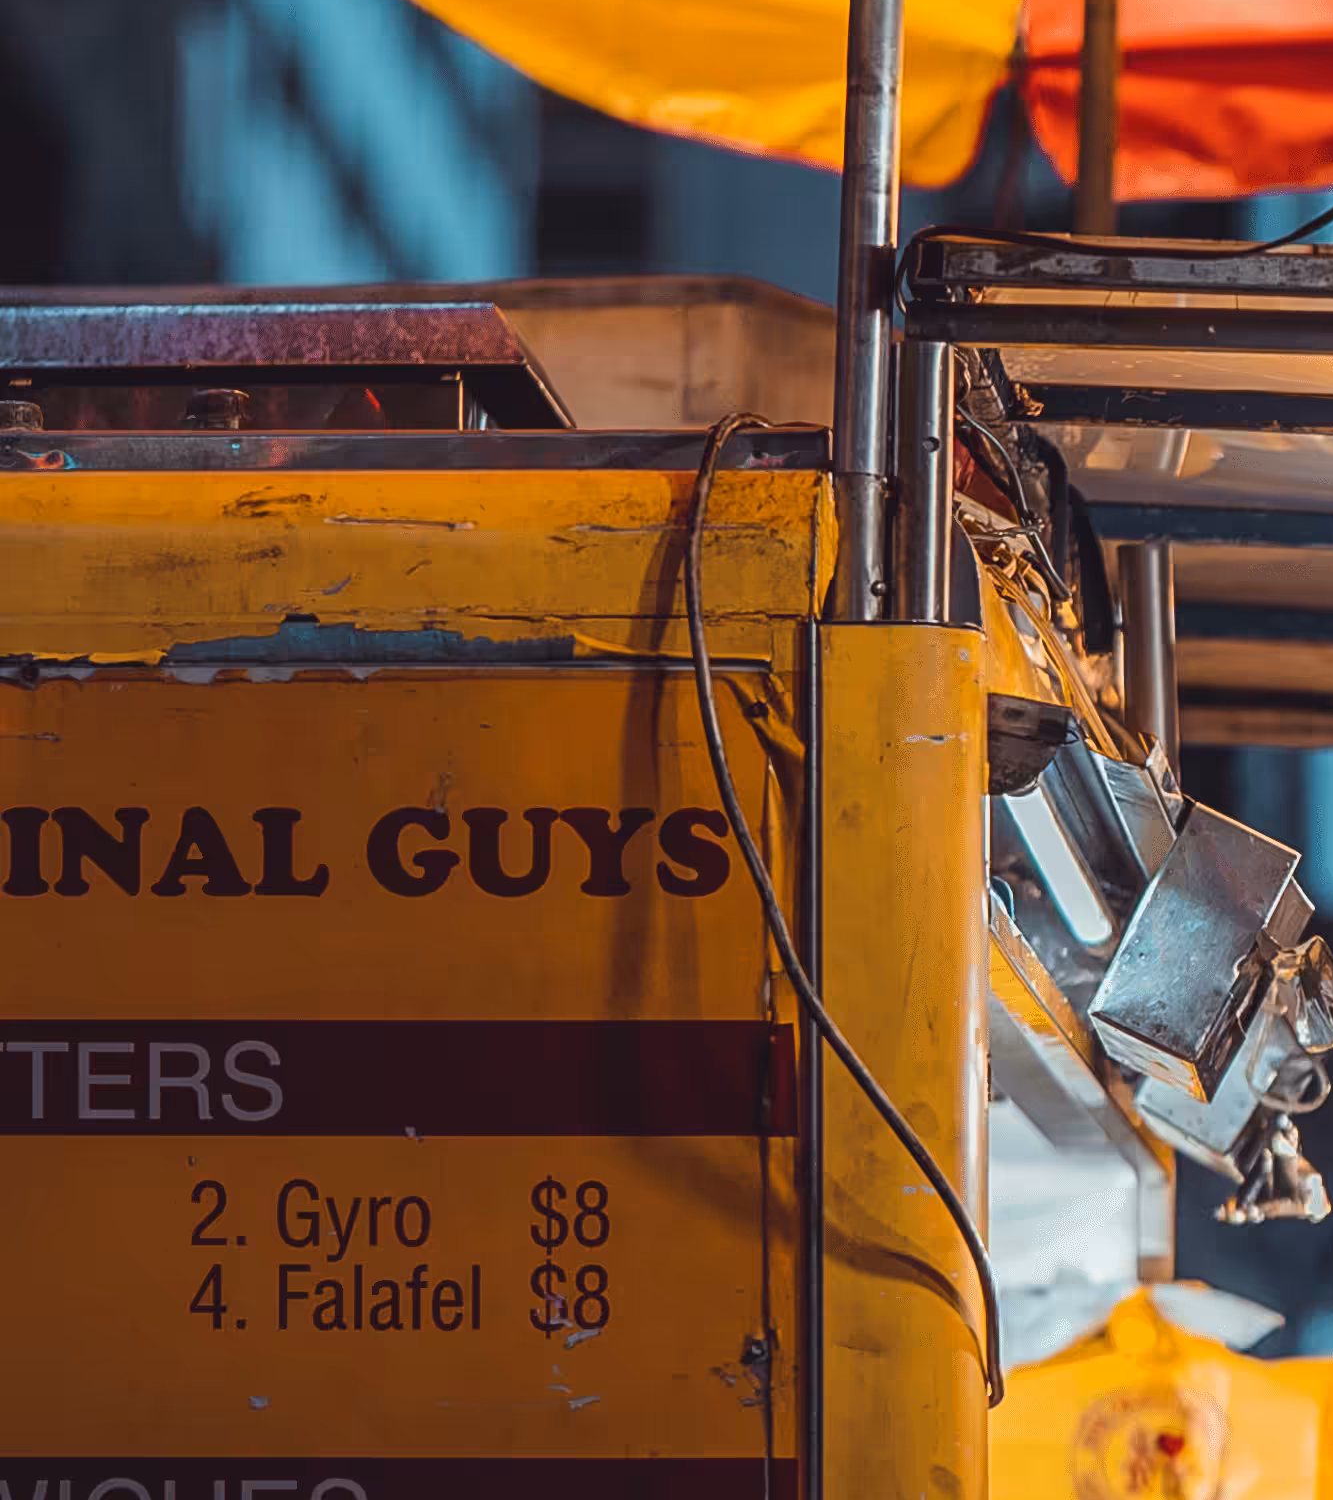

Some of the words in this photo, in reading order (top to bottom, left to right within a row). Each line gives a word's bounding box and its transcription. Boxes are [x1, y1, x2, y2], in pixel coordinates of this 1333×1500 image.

[1, 806, 330, 897] INAL
[367, 806, 732, 898] GUYS
[0, 1041, 284, 1122] TERS
[191, 1179, 247, 1247] 2.
[277, 1178, 431, 1263] Gyro
[530, 1175, 610, 1256] $8
[190, 1263, 247, 1330] 4.
[278, 1263, 481, 1332] Falafel
[529, 1258, 610, 1340] $8
